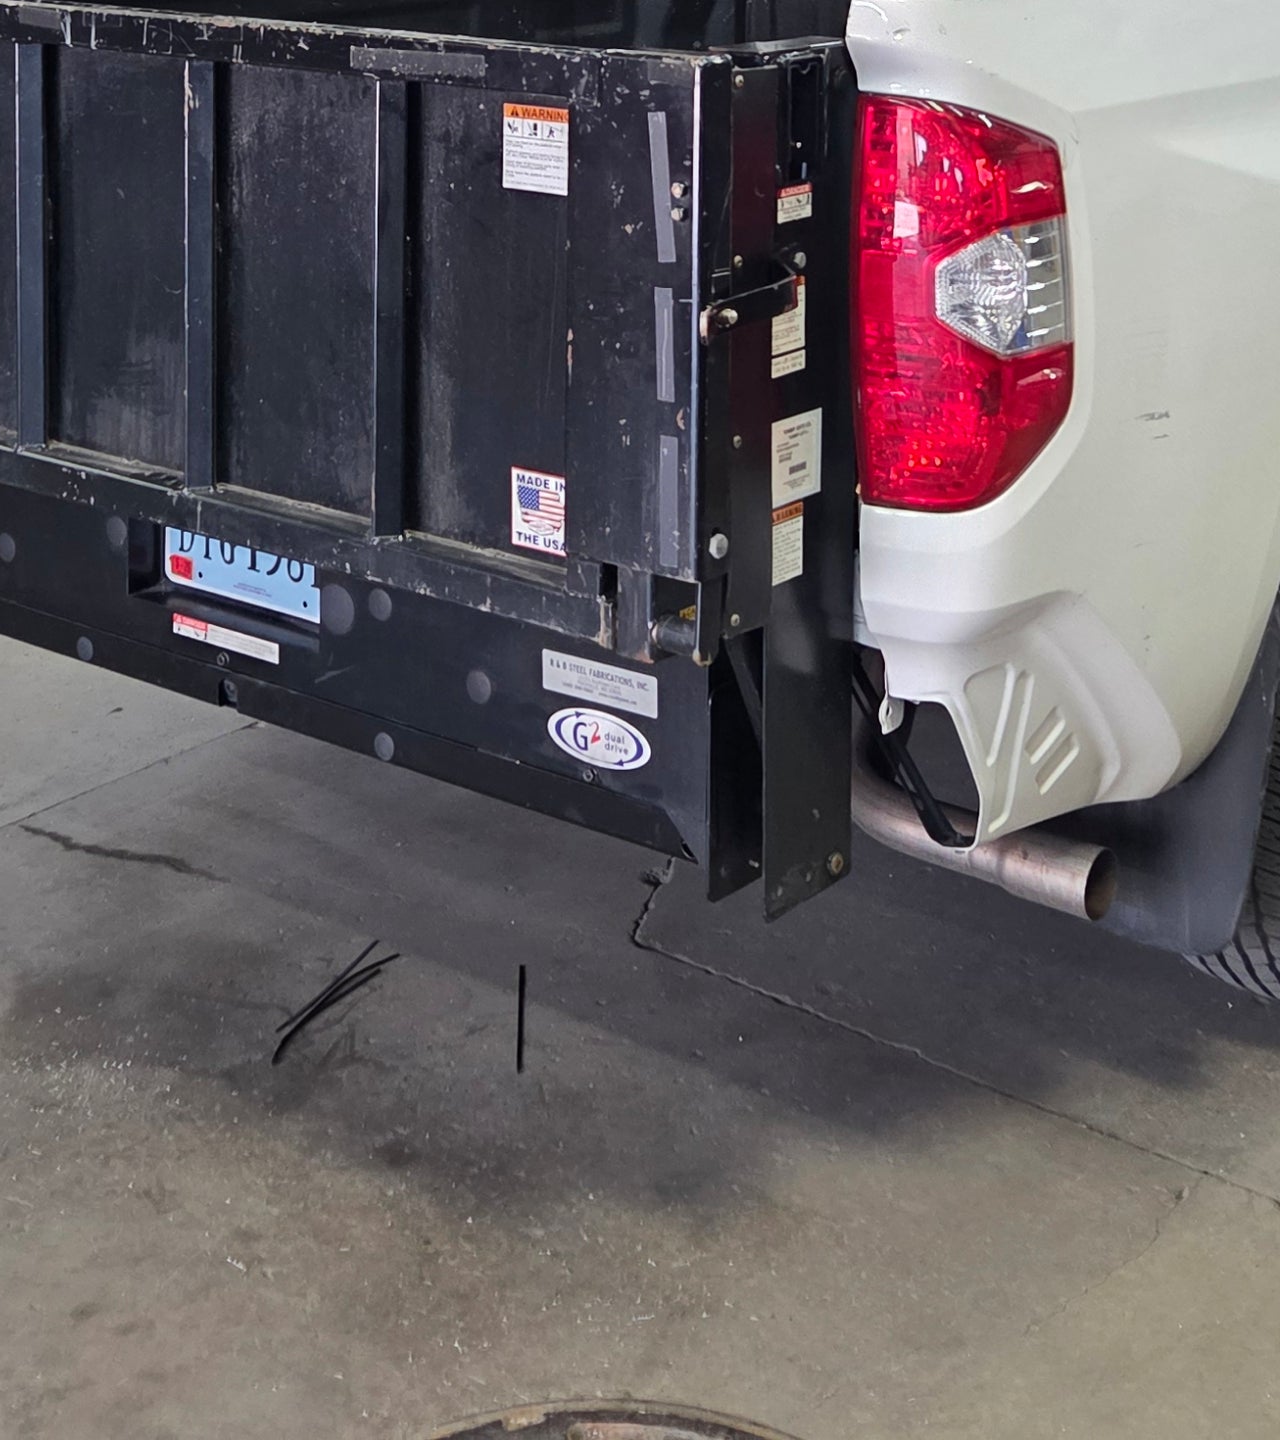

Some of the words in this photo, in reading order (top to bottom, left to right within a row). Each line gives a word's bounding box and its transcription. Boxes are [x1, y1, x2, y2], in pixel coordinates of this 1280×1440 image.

[516, 473, 550, 490] MADE
[516, 530, 540, 546] THE
[569, 663, 588, 676] STEEL
[604, 731, 625, 745] dual
[604, 742, 629, 756] drive
